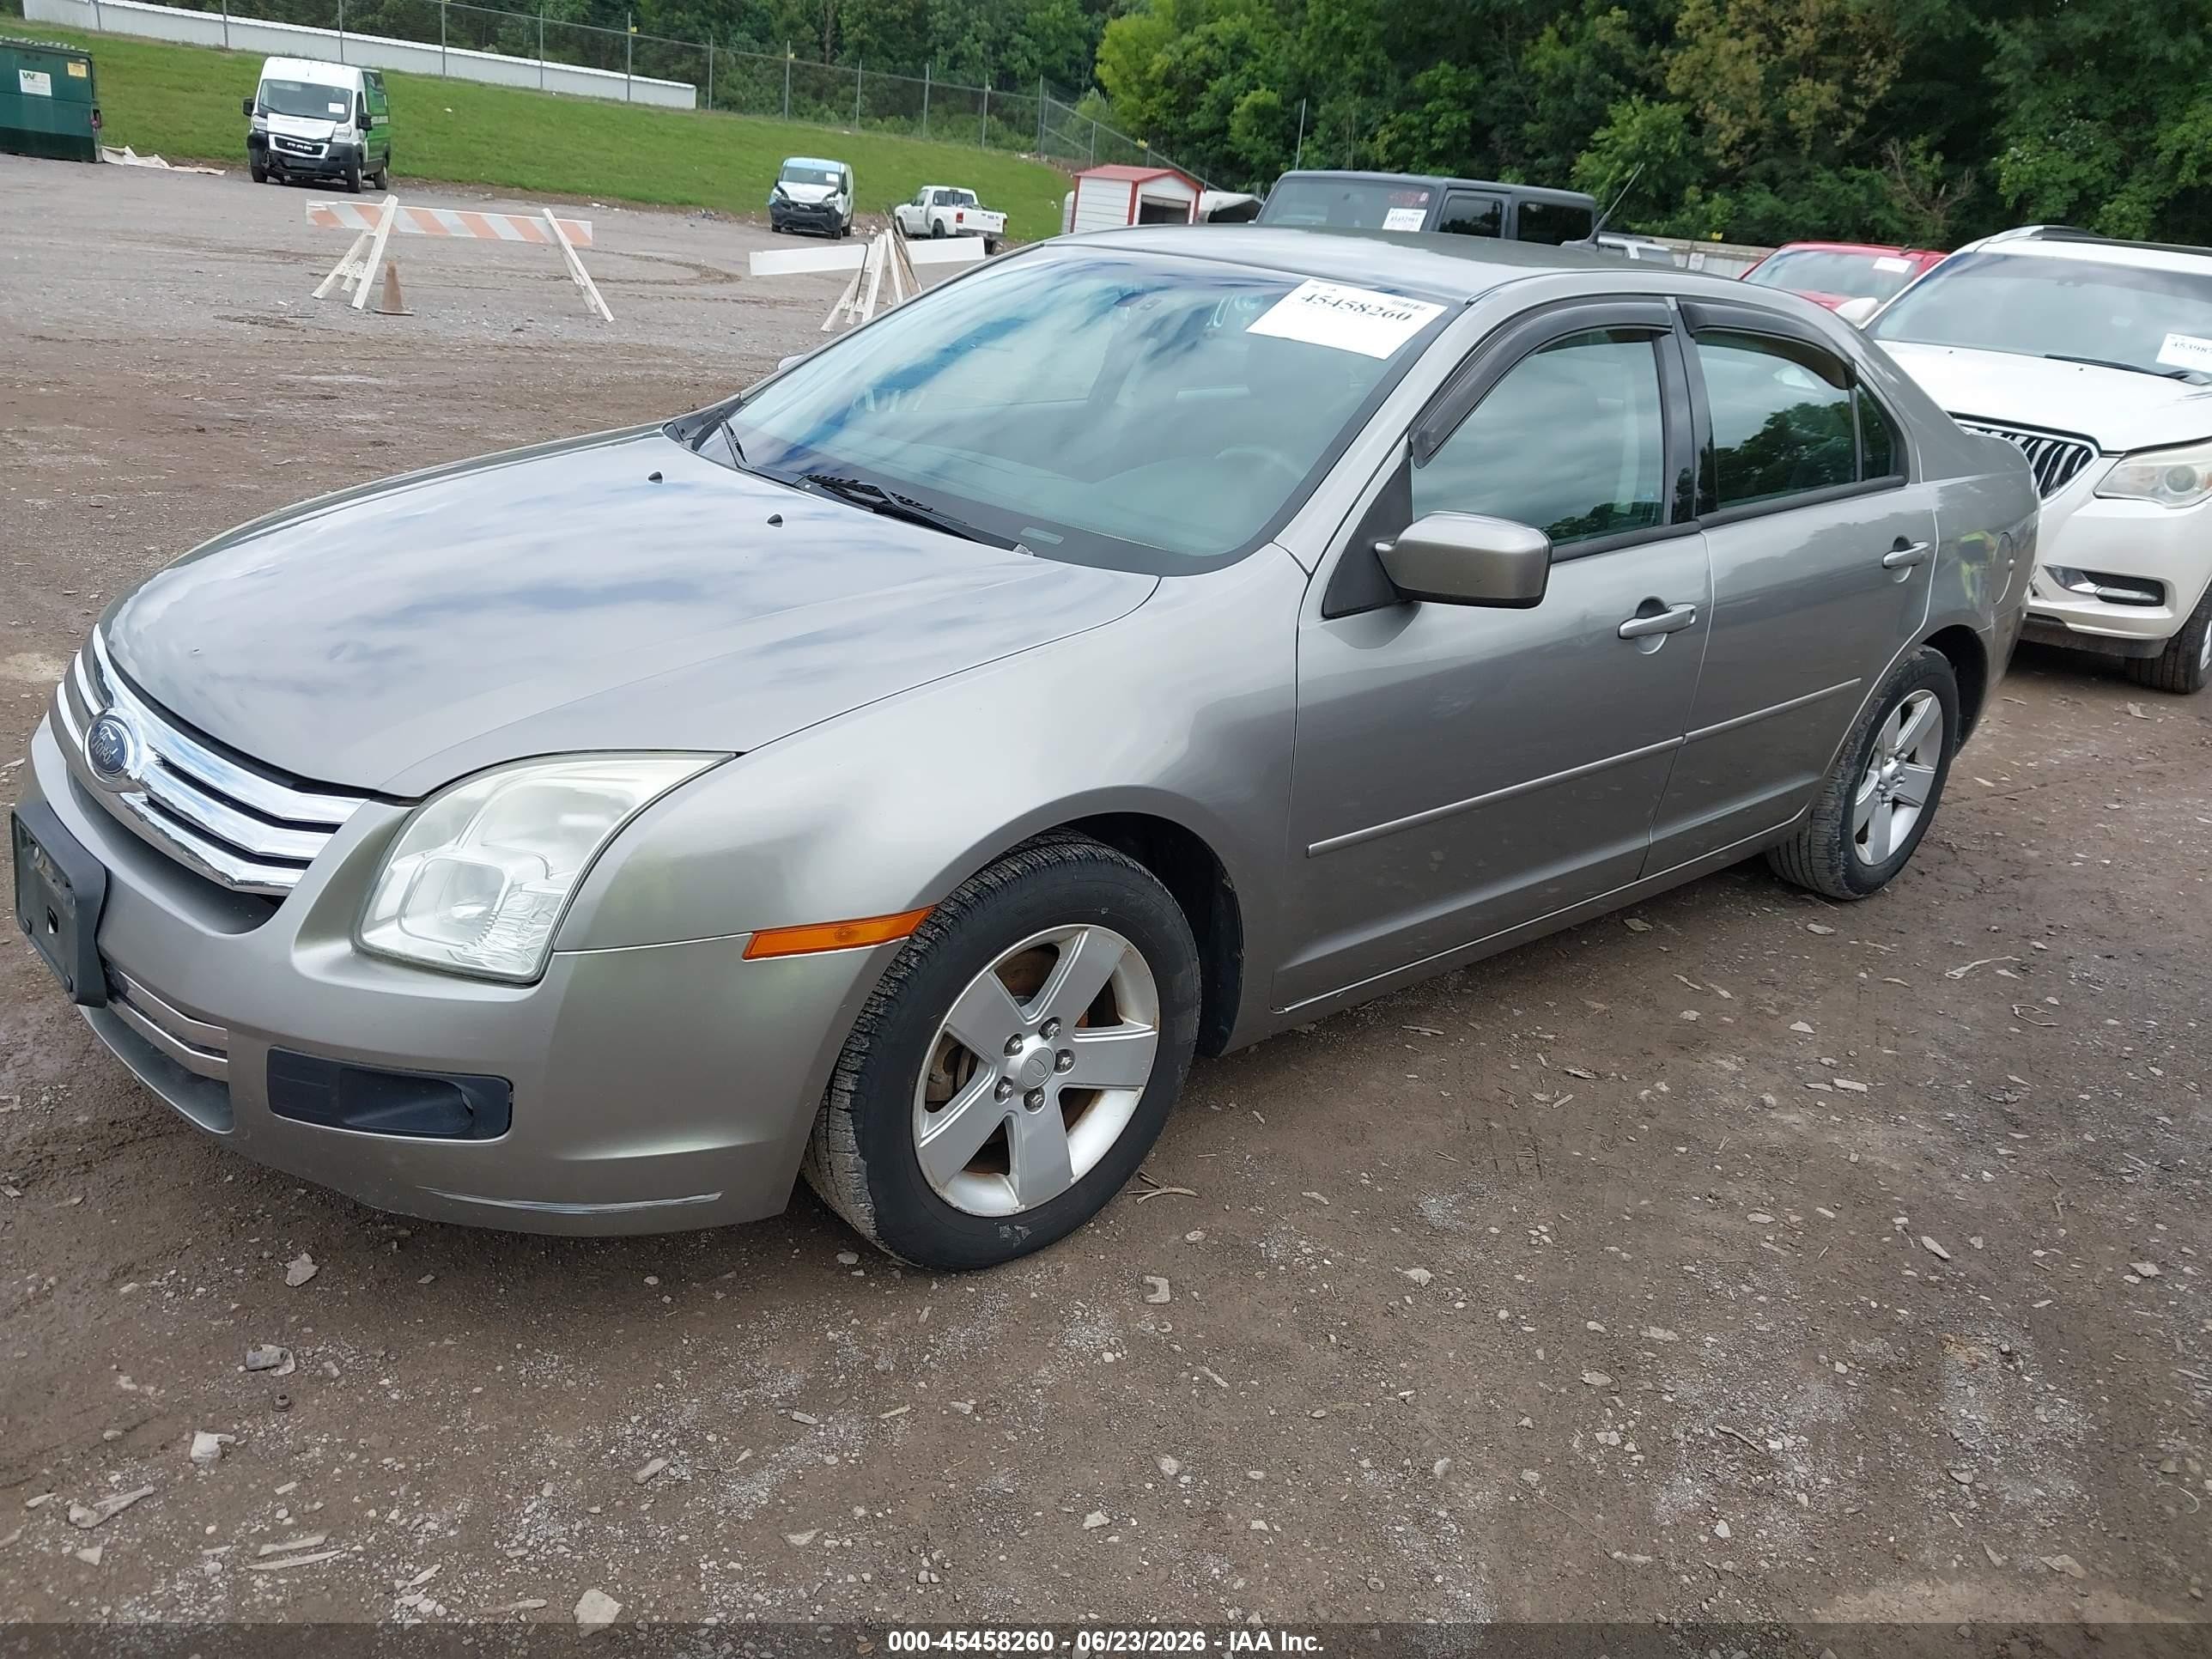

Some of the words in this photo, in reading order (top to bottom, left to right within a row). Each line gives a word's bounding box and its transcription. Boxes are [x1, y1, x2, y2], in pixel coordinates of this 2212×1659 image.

[287, 142, 313, 151] RAM
[1301, 293, 1412, 321] 45458260
[90, 726, 118, 765] Ford
